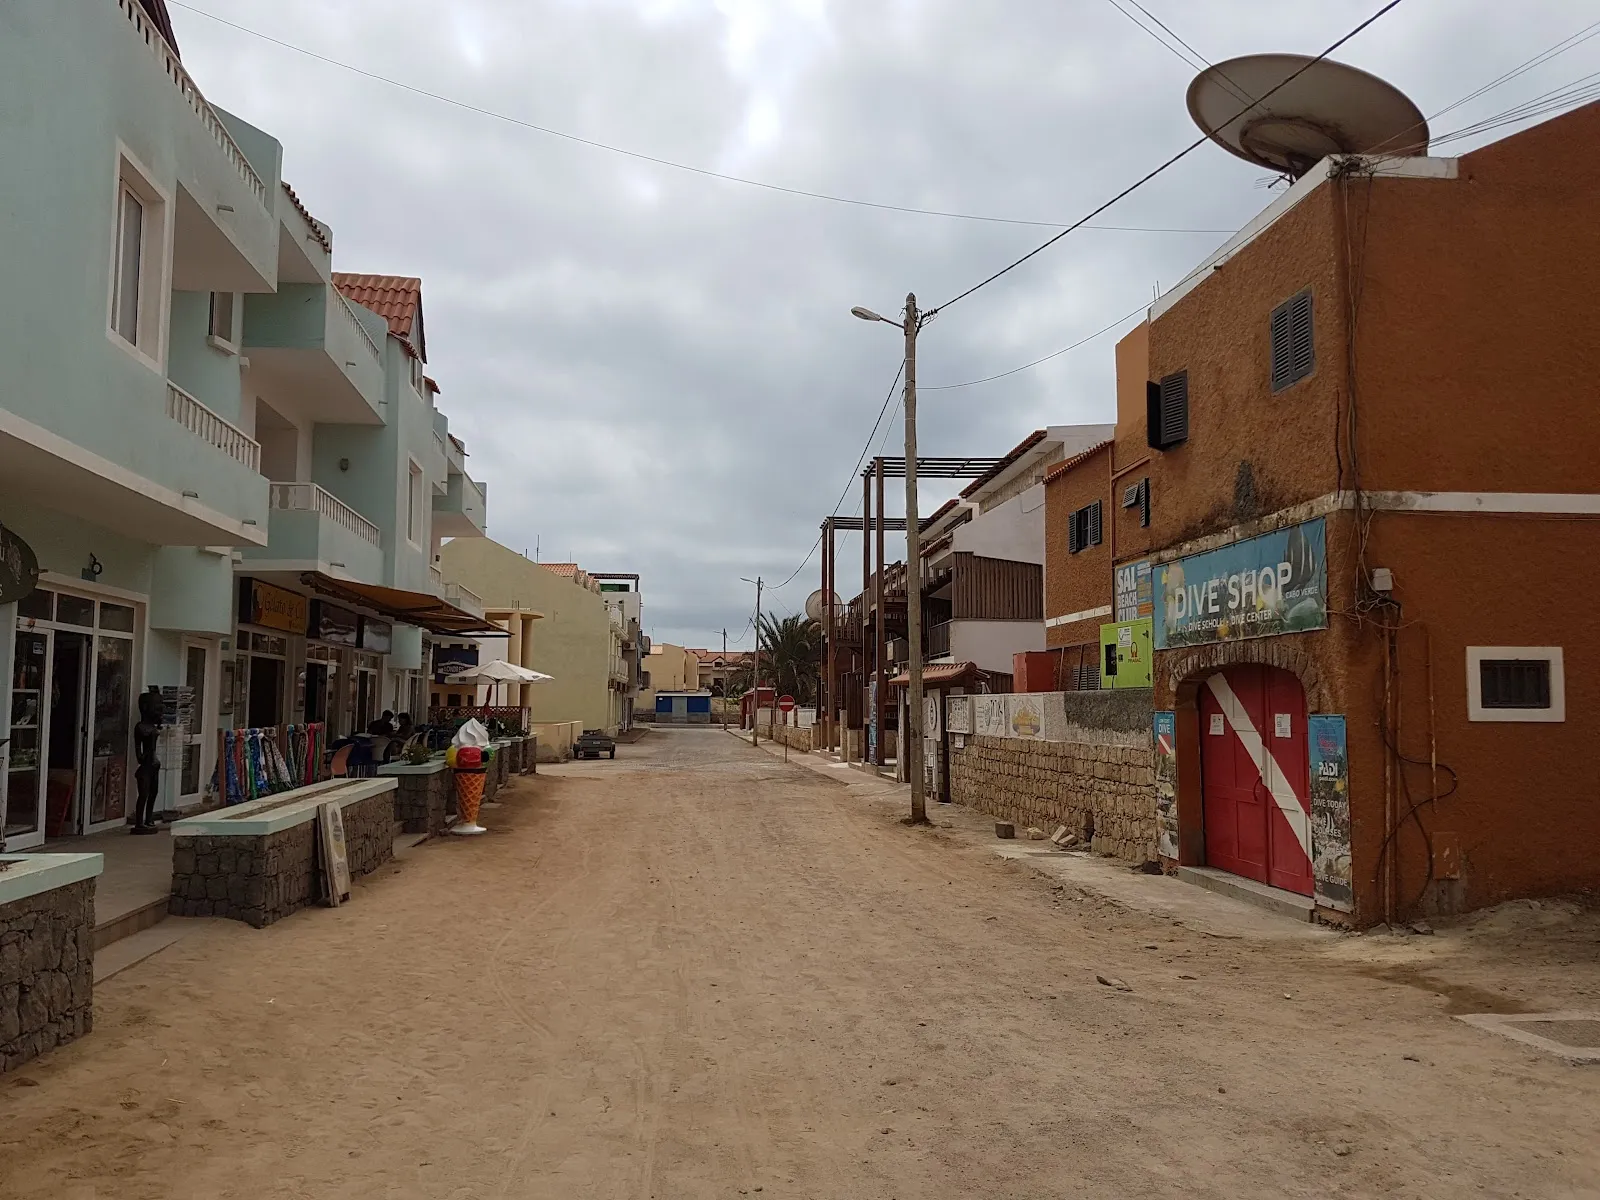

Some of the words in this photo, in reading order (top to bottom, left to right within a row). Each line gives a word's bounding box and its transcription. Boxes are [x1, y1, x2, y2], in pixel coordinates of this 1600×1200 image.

[1117, 566, 1137, 594] SAL
[1174, 578, 1220, 619] DIVE
[1228, 562, 1292, 609] SHOP
[1301, 585, 1318, 596] VERDE
[1117, 591, 1138, 609] BEACH
[1118, 605, 1138, 622] CLUB
[1188, 621, 1201, 631] DIVE
[1231, 613, 1245, 625] DIVE
[1246, 609, 1272, 622] CENTER
[1158, 723, 1171, 734] DIVE
[1318, 761, 1338, 777] PADI
[1313, 798, 1326, 808] DIVE
[1327, 799, 1346, 810] TODAY
[1314, 826, 1342, 838] COURSES
[1329, 875, 1348, 887] GUIDE
